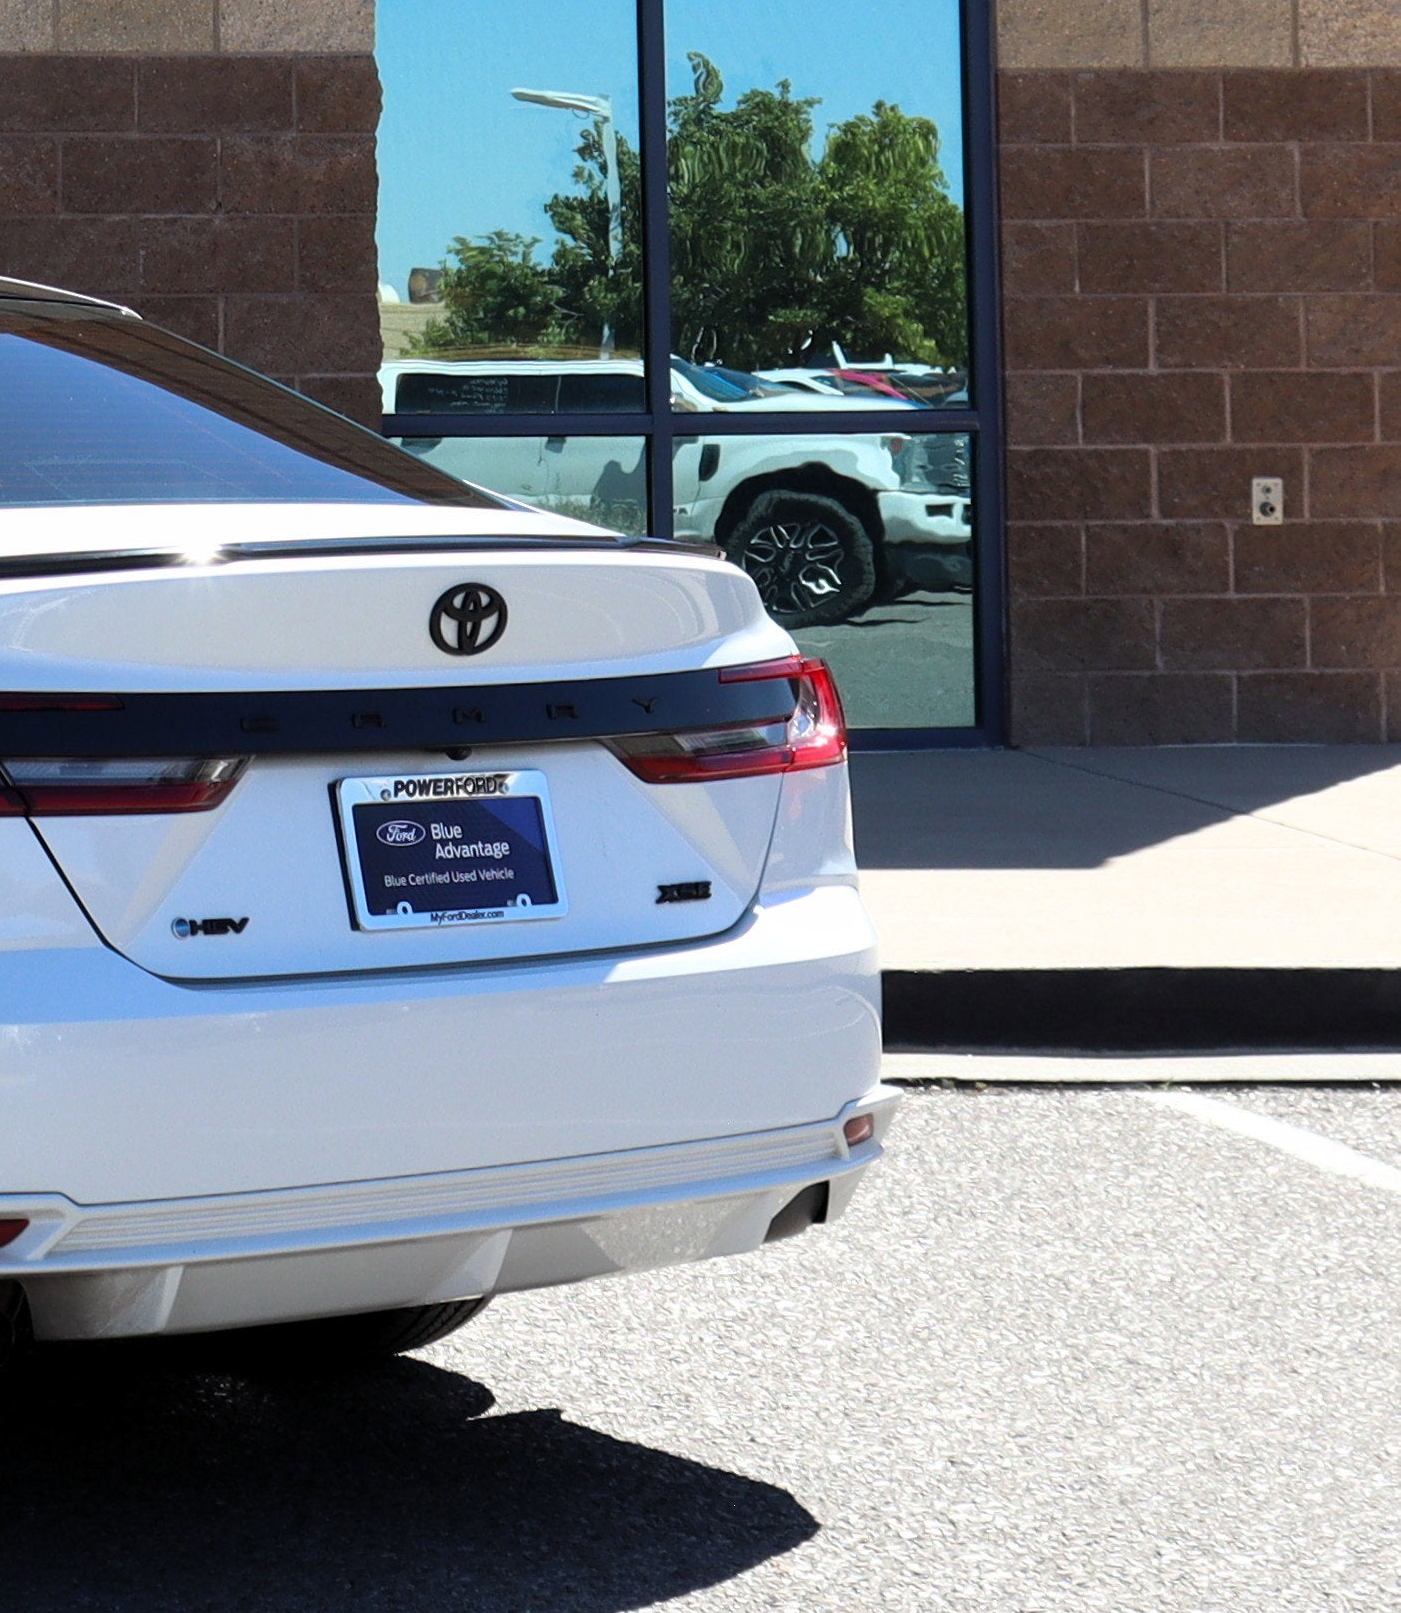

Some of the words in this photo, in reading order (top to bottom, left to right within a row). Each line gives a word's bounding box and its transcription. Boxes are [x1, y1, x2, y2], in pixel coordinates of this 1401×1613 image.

[386, 824, 416, 841] Ford
[430, 822, 463, 840] Blue
[435, 840, 510, 860] Advantage
[383, 874, 407, 888] Blue
[408, 871, 450, 886] Certified
[451, 869, 477, 883] Used
[477, 867, 515, 881] Vehicle
[430, 909, 505, 926] MyFordDealer.com
